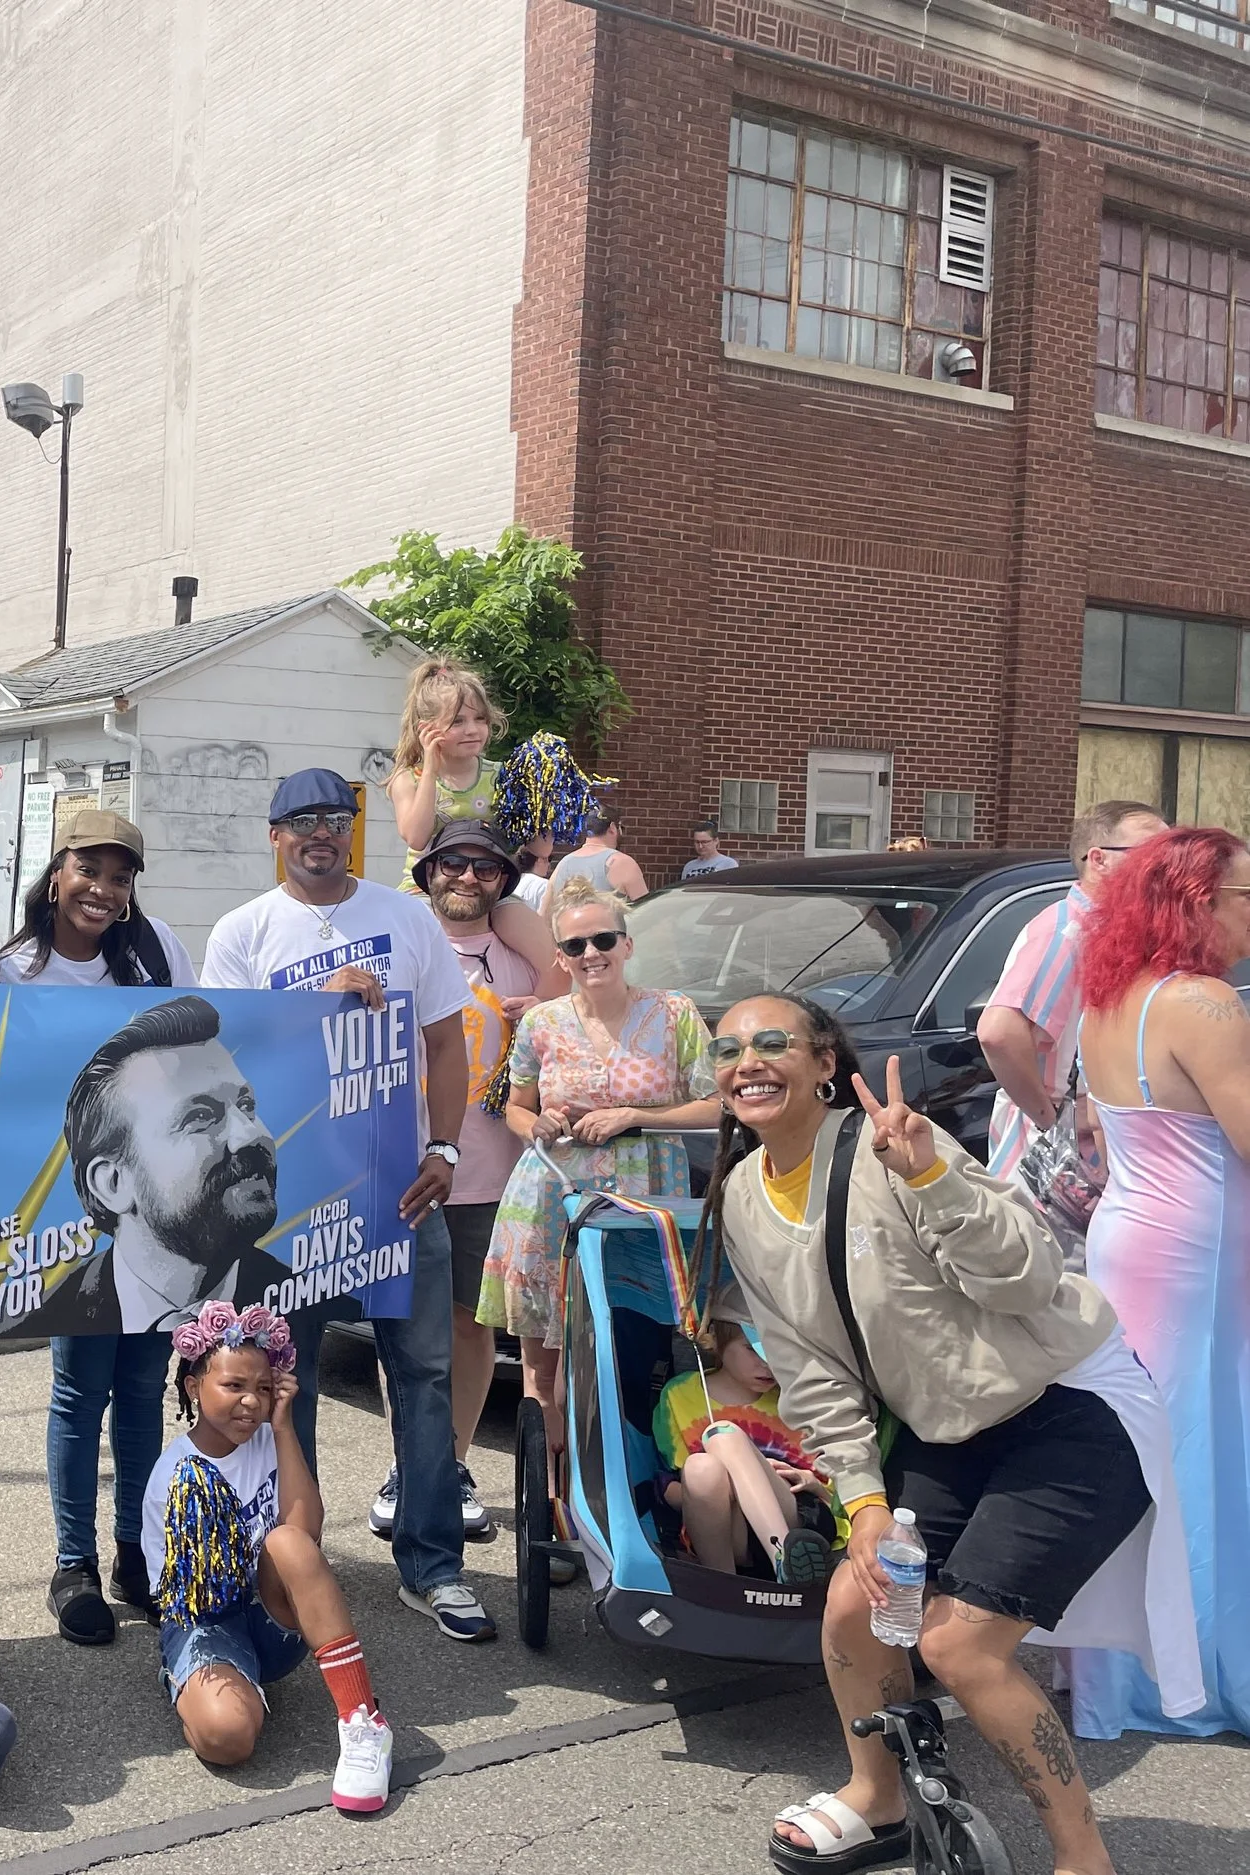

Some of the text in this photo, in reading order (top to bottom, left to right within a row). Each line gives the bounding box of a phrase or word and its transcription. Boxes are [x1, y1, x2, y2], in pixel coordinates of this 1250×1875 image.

[27, 802, 50, 812] PARKING
[37, 792, 50, 801] FREE
[286, 965, 305, 984] I'M
[309, 953, 330, 976] ALL
[332, 948, 348, 967] IN
[350, 939, 375, 961] FOR
[321, 997, 408, 1076] VOTE
[329, 1060, 408, 1120] NOV 4TH
[309, 1198, 350, 1230] JACOB
[291, 1215, 366, 1275] DAVIS
[263, 1239, 411, 1317] COMMISSION
[744, 1590, 803, 1607] THULE
